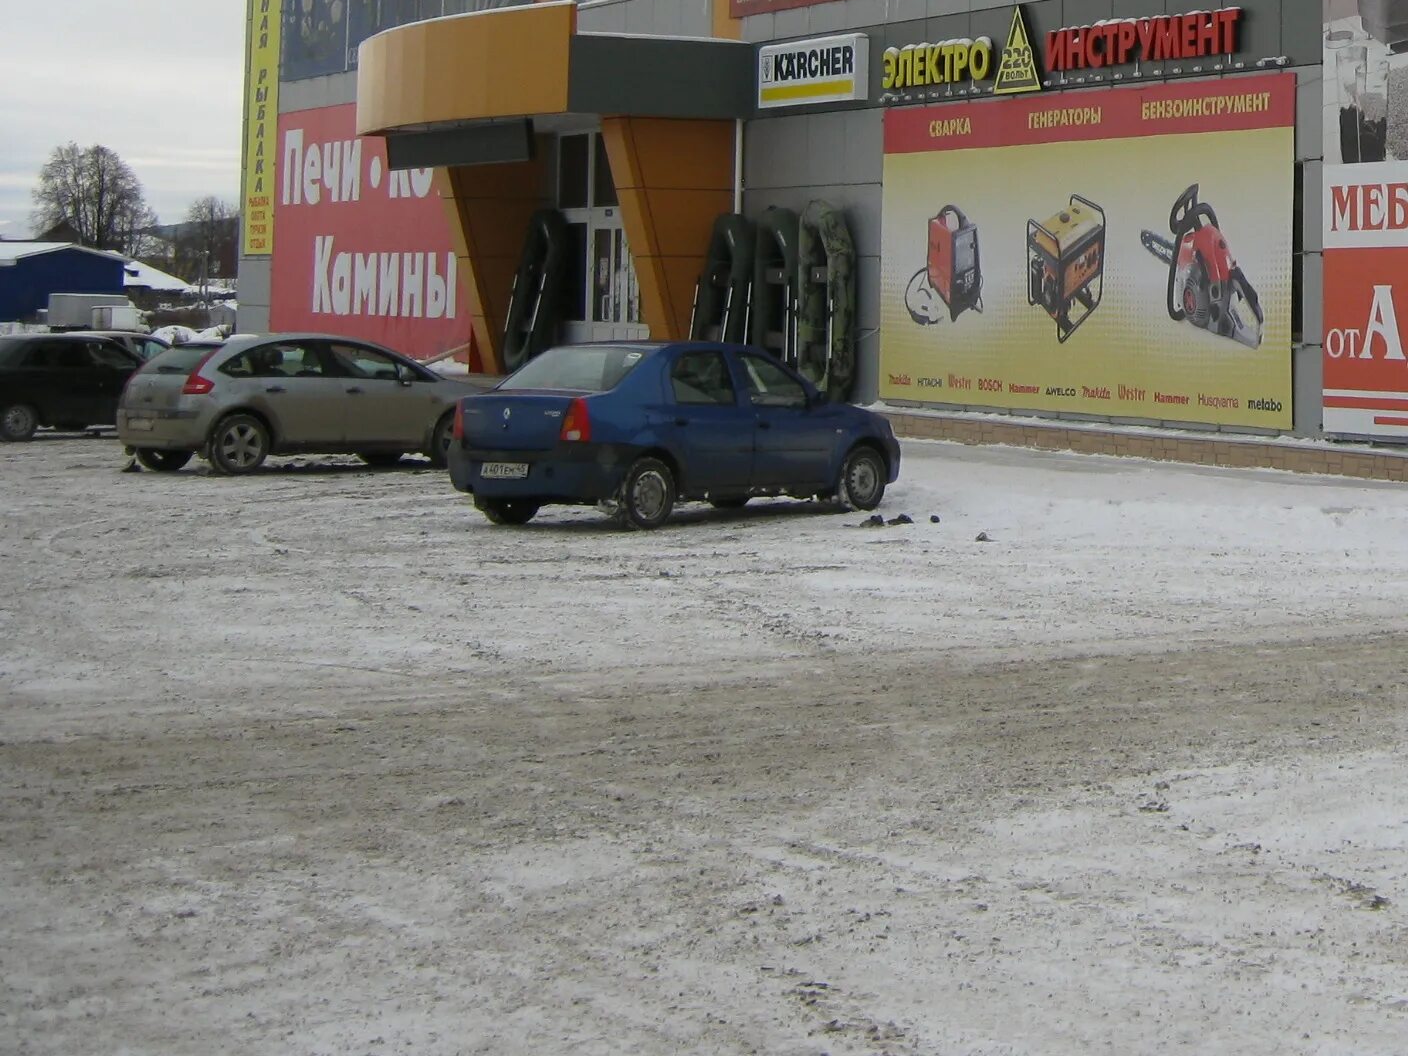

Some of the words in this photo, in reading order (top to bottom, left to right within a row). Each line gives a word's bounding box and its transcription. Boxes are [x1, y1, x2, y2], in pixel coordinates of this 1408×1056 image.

[881, 39, 991, 90] ЭЛЕКТРО
[1044, 7, 1242, 73] ИНСТРУМЕНТ
[1002, 45, 1033, 70] 220
[1005, 69, 1029, 81] ВОЛЬТ
[1028, 106, 1102, 130] ГЕНЕРАТОРЫ
[1141, 91, 1271, 121] БЕНЗОИНСТРУМЕНТ
[254, 68, 269, 193] РЫБАЛКА
[929, 117, 972, 138] СВАРКА
[283, 129, 362, 205] Печи
[312, 235, 457, 319] Камины
[978, 378, 1003, 392] BOSCH
[1008, 383, 1040, 394] Hammer
[1045, 386, 1077, 397] AWELCO
[1153, 391, 1190, 405] Hammer
[1197, 393, 1239, 410] Husqvarna
[1247, 398, 1282, 413] metabo
